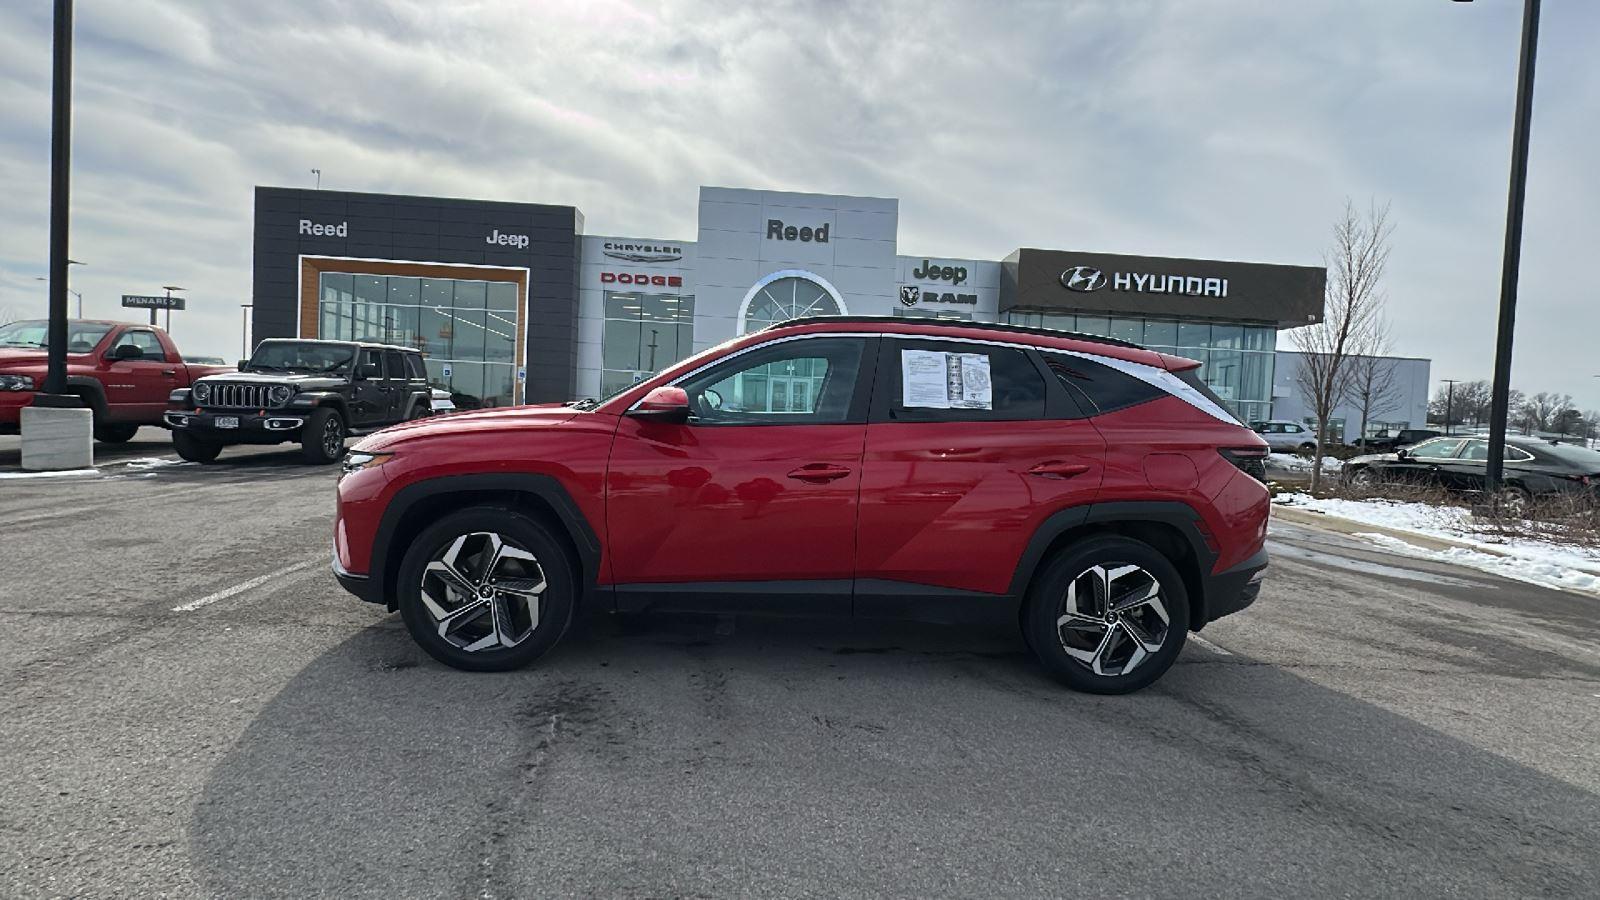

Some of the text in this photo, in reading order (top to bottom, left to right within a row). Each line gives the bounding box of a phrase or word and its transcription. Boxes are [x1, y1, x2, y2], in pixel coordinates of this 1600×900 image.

[299, 219, 348, 237] Reed
[767, 219, 829, 243] Reed
[486, 229, 529, 249] Jeep
[604, 243, 681, 254] CHRYSLER
[601, 272, 682, 287] DODGE
[913, 260, 967, 285] Jeep
[1113, 271, 1228, 297] HYUNDAI
[923, 292, 977, 304] RAM
